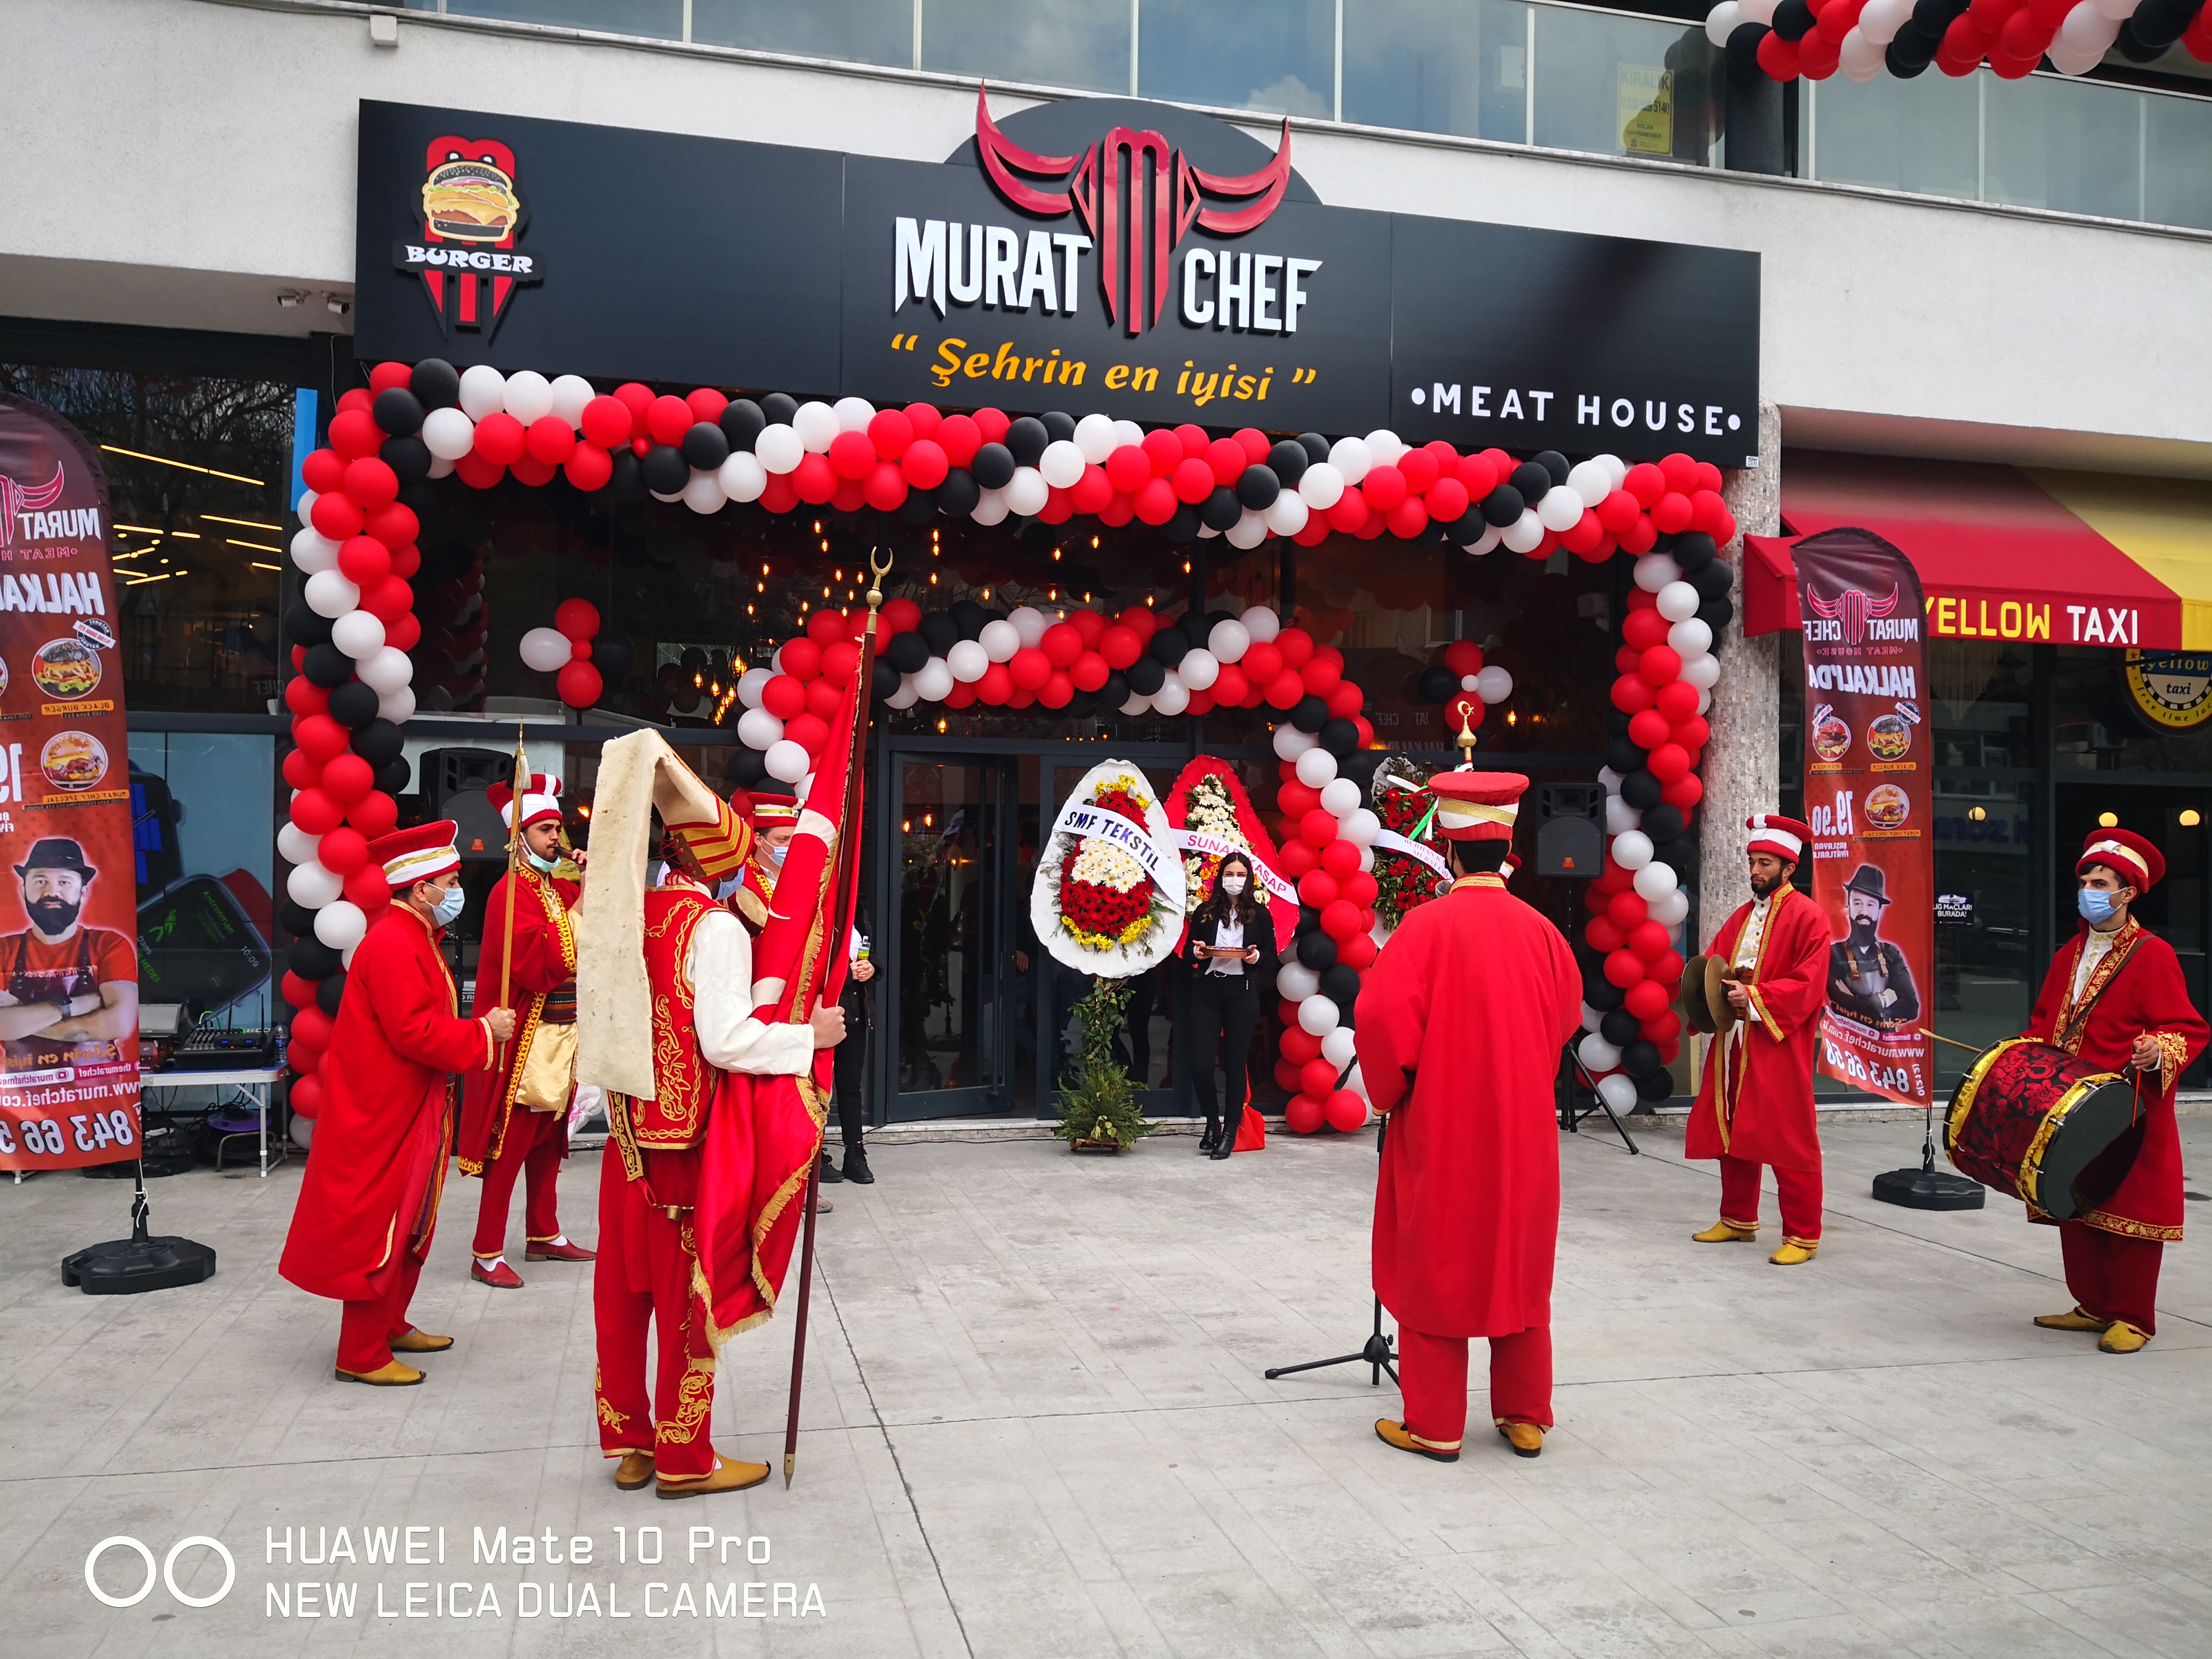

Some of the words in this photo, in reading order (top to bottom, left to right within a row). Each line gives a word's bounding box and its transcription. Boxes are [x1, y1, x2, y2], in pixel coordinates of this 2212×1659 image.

[405, 245, 533, 274] BURGER
[895, 216, 1093, 317] MURAT
[1183, 248, 1323, 332] CHEF
[930, 338, 1086, 387] Şehrin
[1104, 363, 1159, 392] en
[1177, 359, 1274, 407] iyisi
[1433, 382, 1554, 422] MEAT
[1577, 394, 1723, 435] HOUSE
[2067, 605, 2138, 645] TAXI
[2136, 686, 2156, 711] free
[2162, 712, 2189, 721] time
[2166, 682, 2191, 695] taxi
[1065, 811, 1098, 830] SMF
[1101, 818, 1160, 871] TEKSTİL
[1404, 839, 1434, 857] BURHAN
[1413, 850, 1438, 867] MURAT
[242, 945, 259, 968] 10:09
